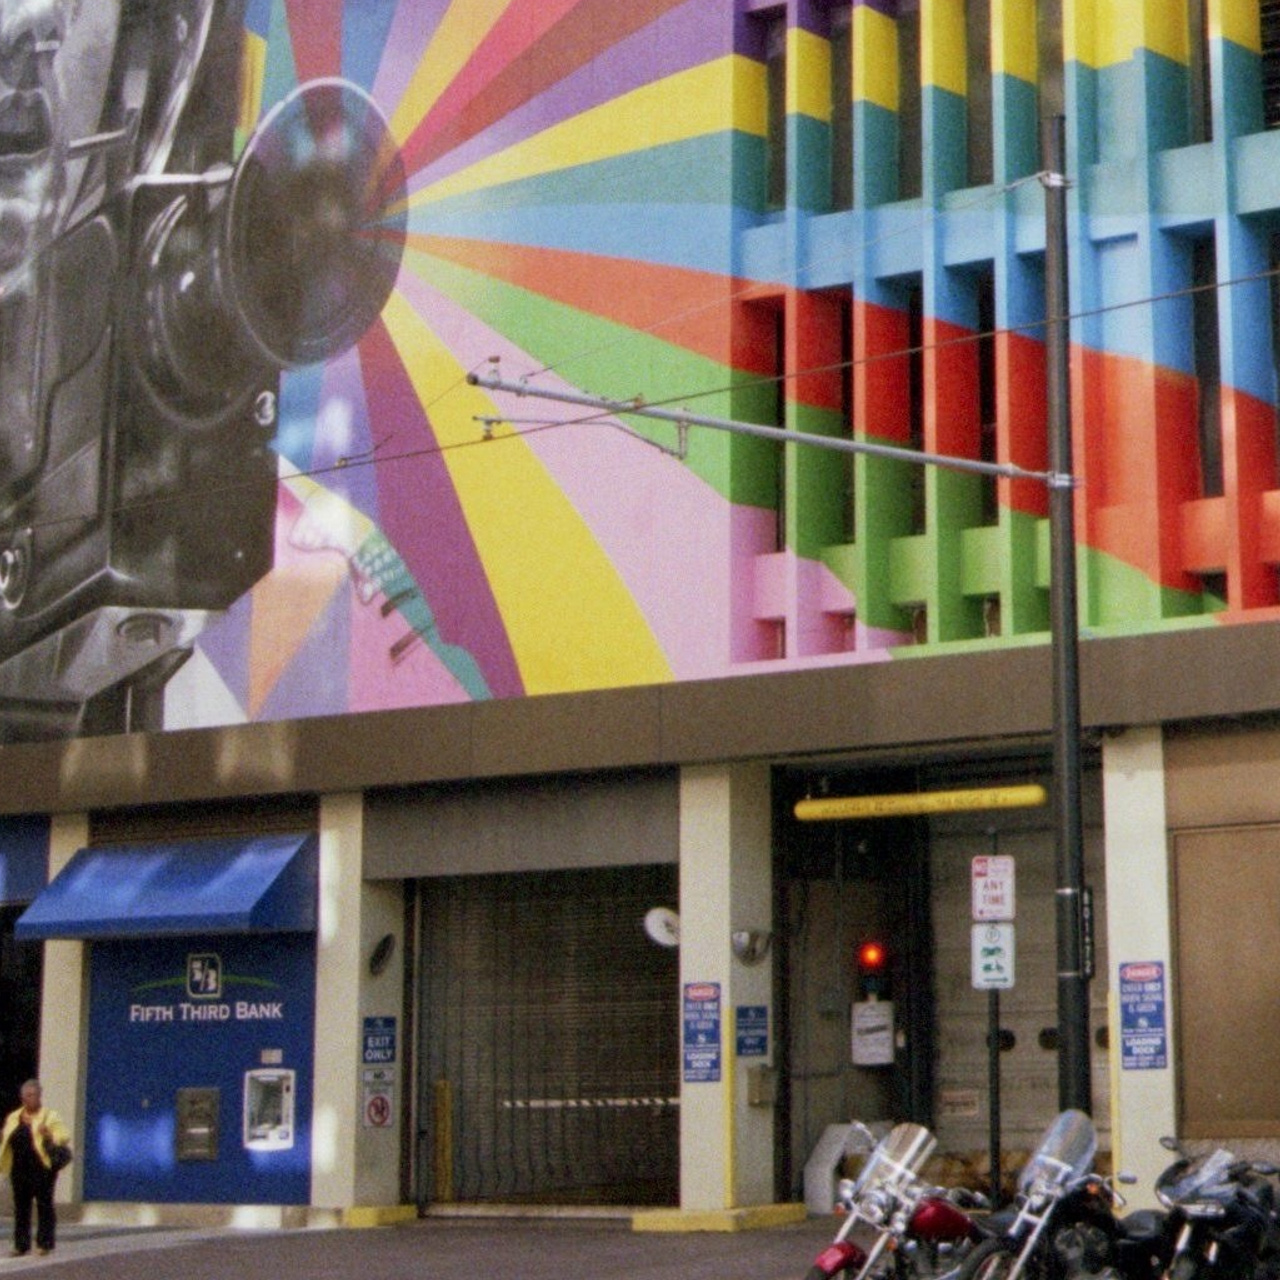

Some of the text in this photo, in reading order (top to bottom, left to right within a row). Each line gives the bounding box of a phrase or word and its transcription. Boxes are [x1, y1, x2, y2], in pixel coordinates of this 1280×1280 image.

[983, 880, 1004, 891] ANY
[982, 894, 1006, 906] TIME
[130, 1001, 284, 1022] FIFTH THIRD BANK
[367, 1036, 391, 1048] EXIT
[1125, 1037, 1162, 1047] LOADING
[365, 1049, 393, 1060] ONLY
[1132, 1046, 1155, 1055] DOCK
